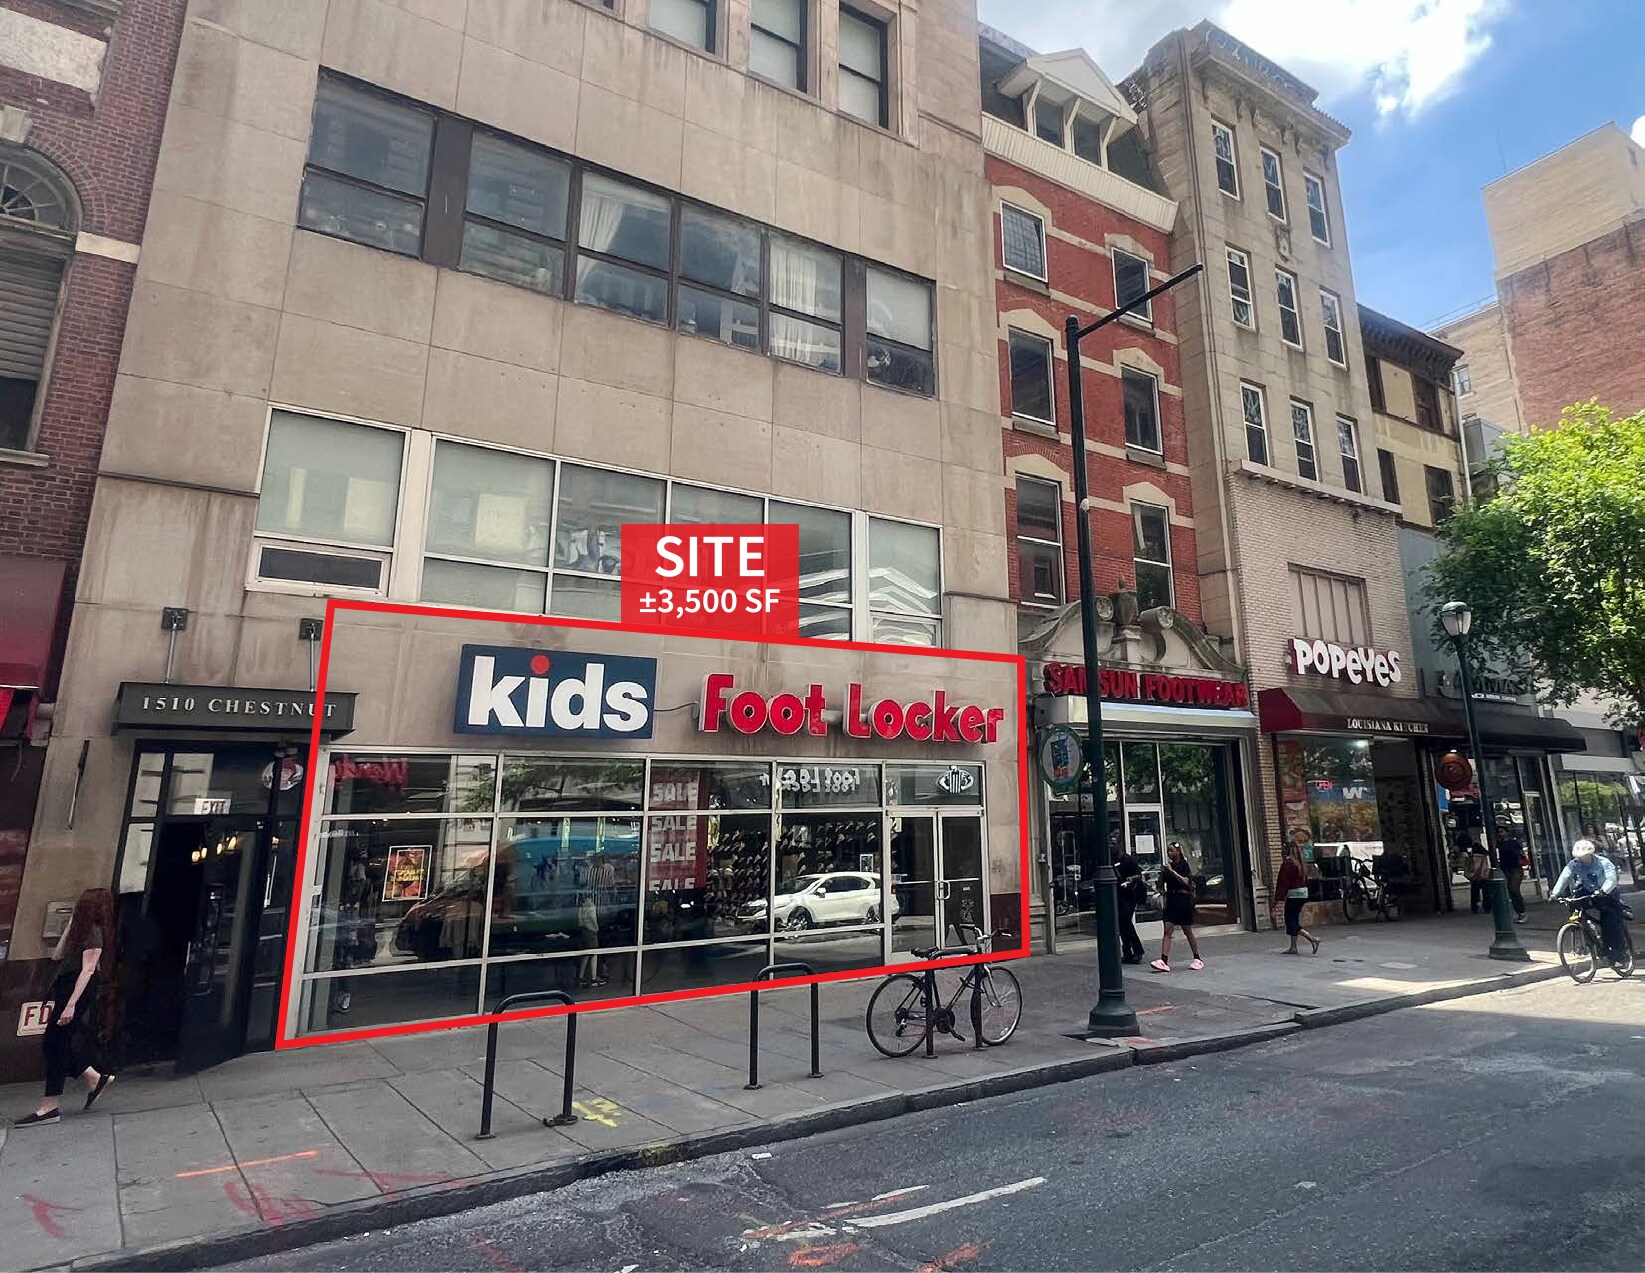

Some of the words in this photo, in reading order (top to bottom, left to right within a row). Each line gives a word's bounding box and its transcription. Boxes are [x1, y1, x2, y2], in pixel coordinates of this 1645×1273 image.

[468, 654, 648, 732] kids
[1140, 673, 1249, 708] FOOTWEAR
[143, 697, 196, 711] 1510
[702, 673, 828, 735] Foot
[845, 681, 1004, 744] Locker
[1347, 717, 1392, 731] LOUISIANA
[1393, 720, 1429, 733] KICHEN
[652, 782, 698, 801] SALE
[651, 815, 697, 831] SALE
[650, 841, 697, 863] SALE
